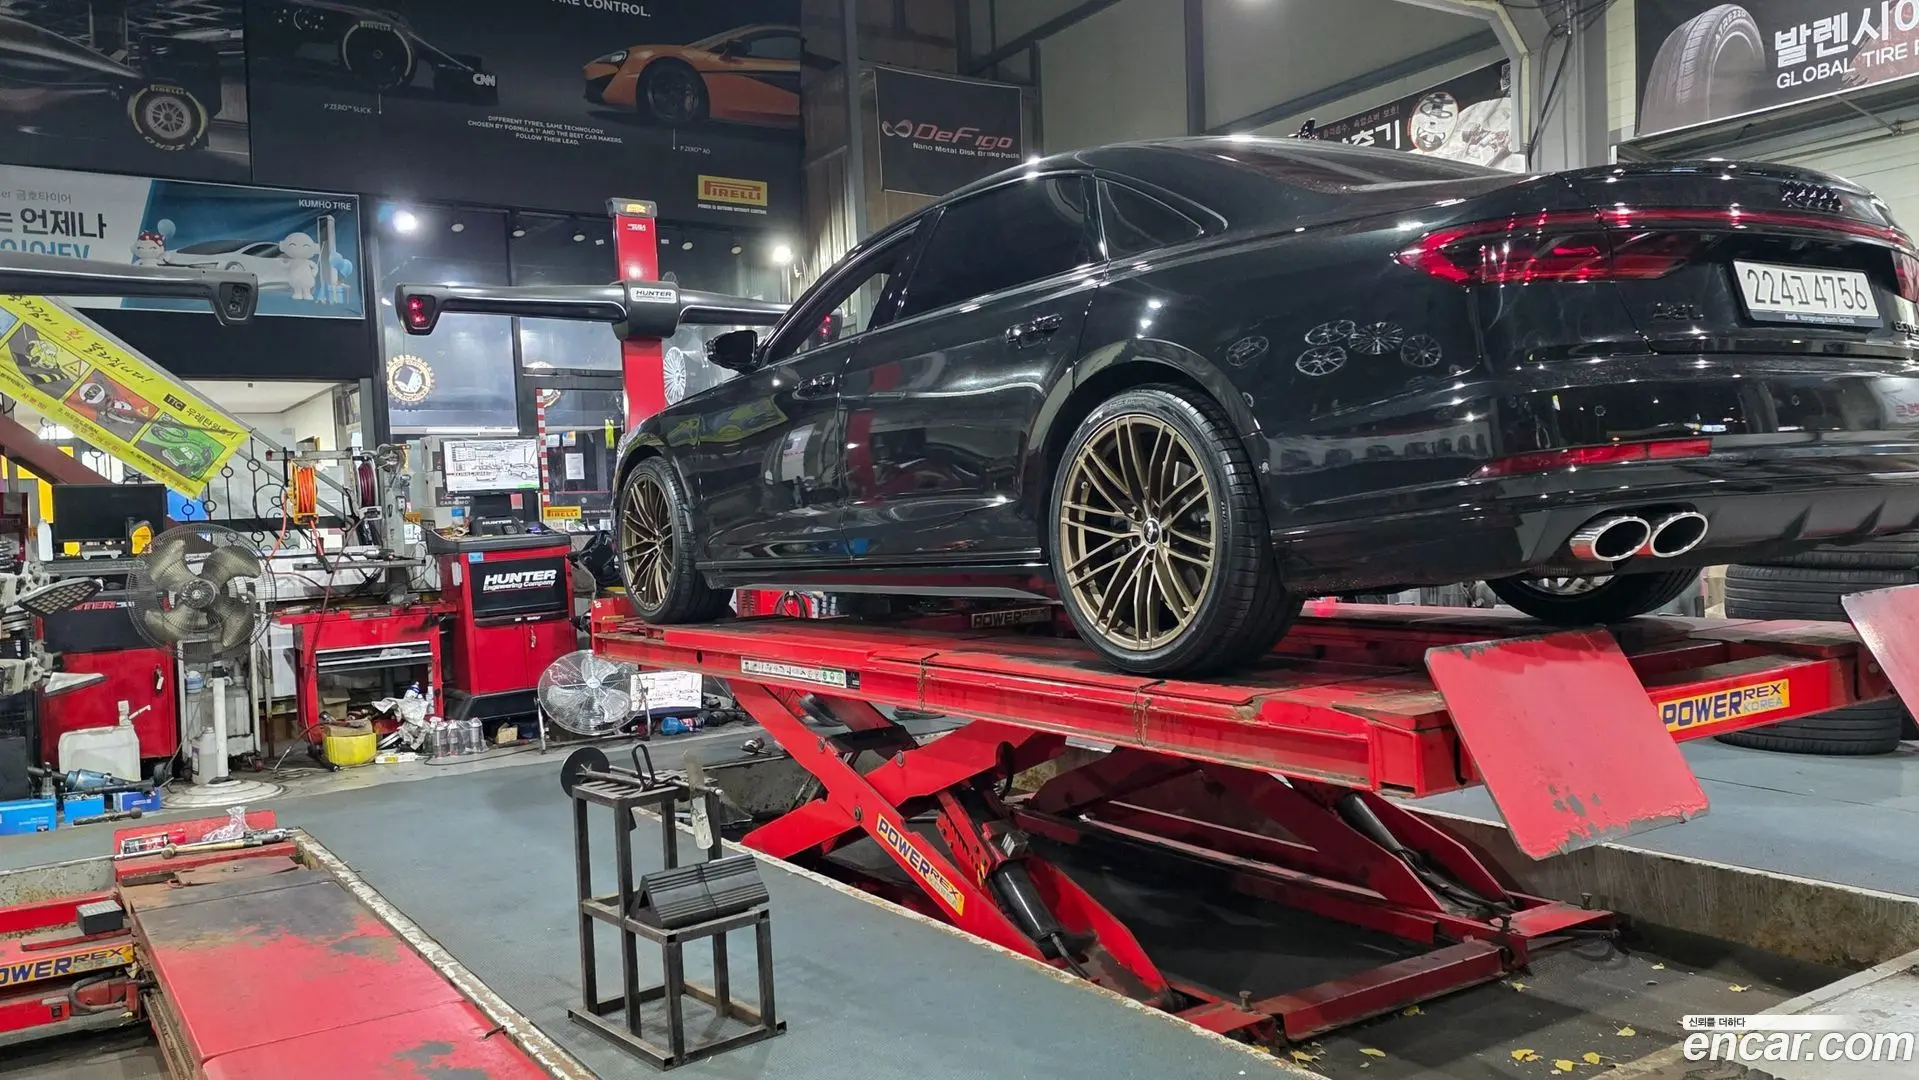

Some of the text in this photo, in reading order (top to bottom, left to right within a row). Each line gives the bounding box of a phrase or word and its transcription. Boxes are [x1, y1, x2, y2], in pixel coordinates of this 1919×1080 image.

[1776, 57, 1856, 89] GLOBAL
[1862, 42, 1908, 67] TIRE
[472, 73, 496, 87] CNN
[467, 119, 495, 128] CHOSEN
[504, 124, 535, 134] FORMULA
[568, 131, 585, 140] BEST
[487, 115, 523, 125] DIFFERENT
[546, 122, 564, 130] SAME
[515, 132, 542, 141] FOLLOW
[543, 135, 562, 143] THEIR
[912, 142, 1020, 161] Nano Metal Disk Brake Pads
[16, 189, 72, 205] 금호타이어
[703, 180, 762, 201] PIRELLI
[298, 198, 352, 212] KUMHO TIRE
[20, 207, 108, 239] 언제나
[635, 289, 672, 297] HUNTER
[1747, 269, 1867, 310] 224고 4756
[546, 509, 578, 518] PIRELLI
[484, 569, 557, 585] HUNTER
[483, 580, 556, 592] Engineering Company
[1662, 683, 1782, 727] POWER REX
[1743, 697, 1783, 714] KOREA
[878, 817, 959, 900] POWER REX
[73, 947, 123, 963] REX
